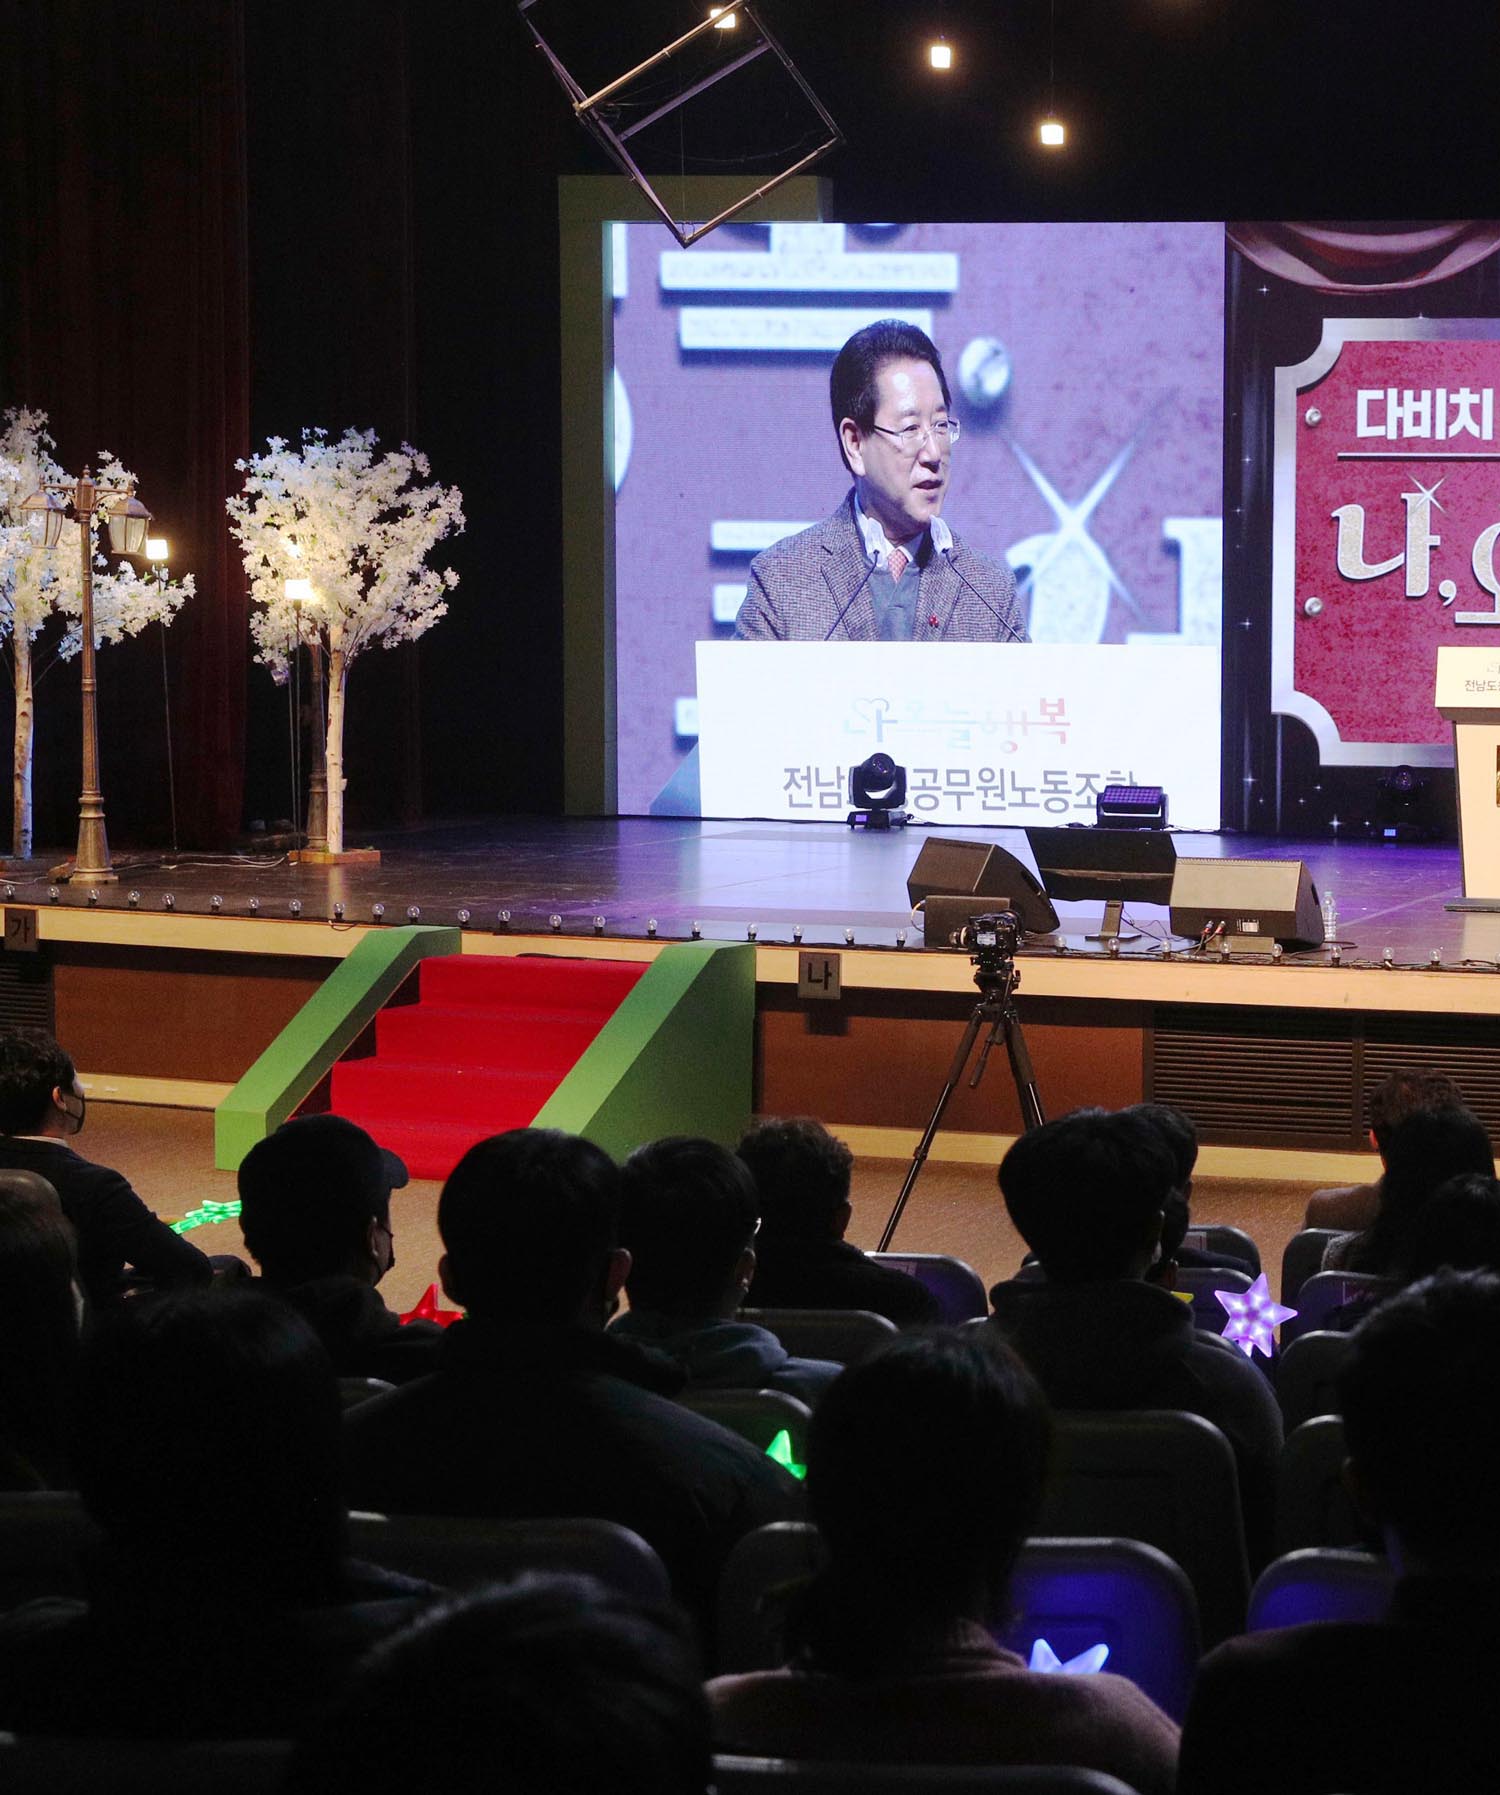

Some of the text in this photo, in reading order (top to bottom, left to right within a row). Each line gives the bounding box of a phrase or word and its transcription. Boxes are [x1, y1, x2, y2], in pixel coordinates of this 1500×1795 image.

[1356, 387, 1494, 440] 다비치
[9, 916, 31, 944] 가
[807, 961, 832, 991] 나
